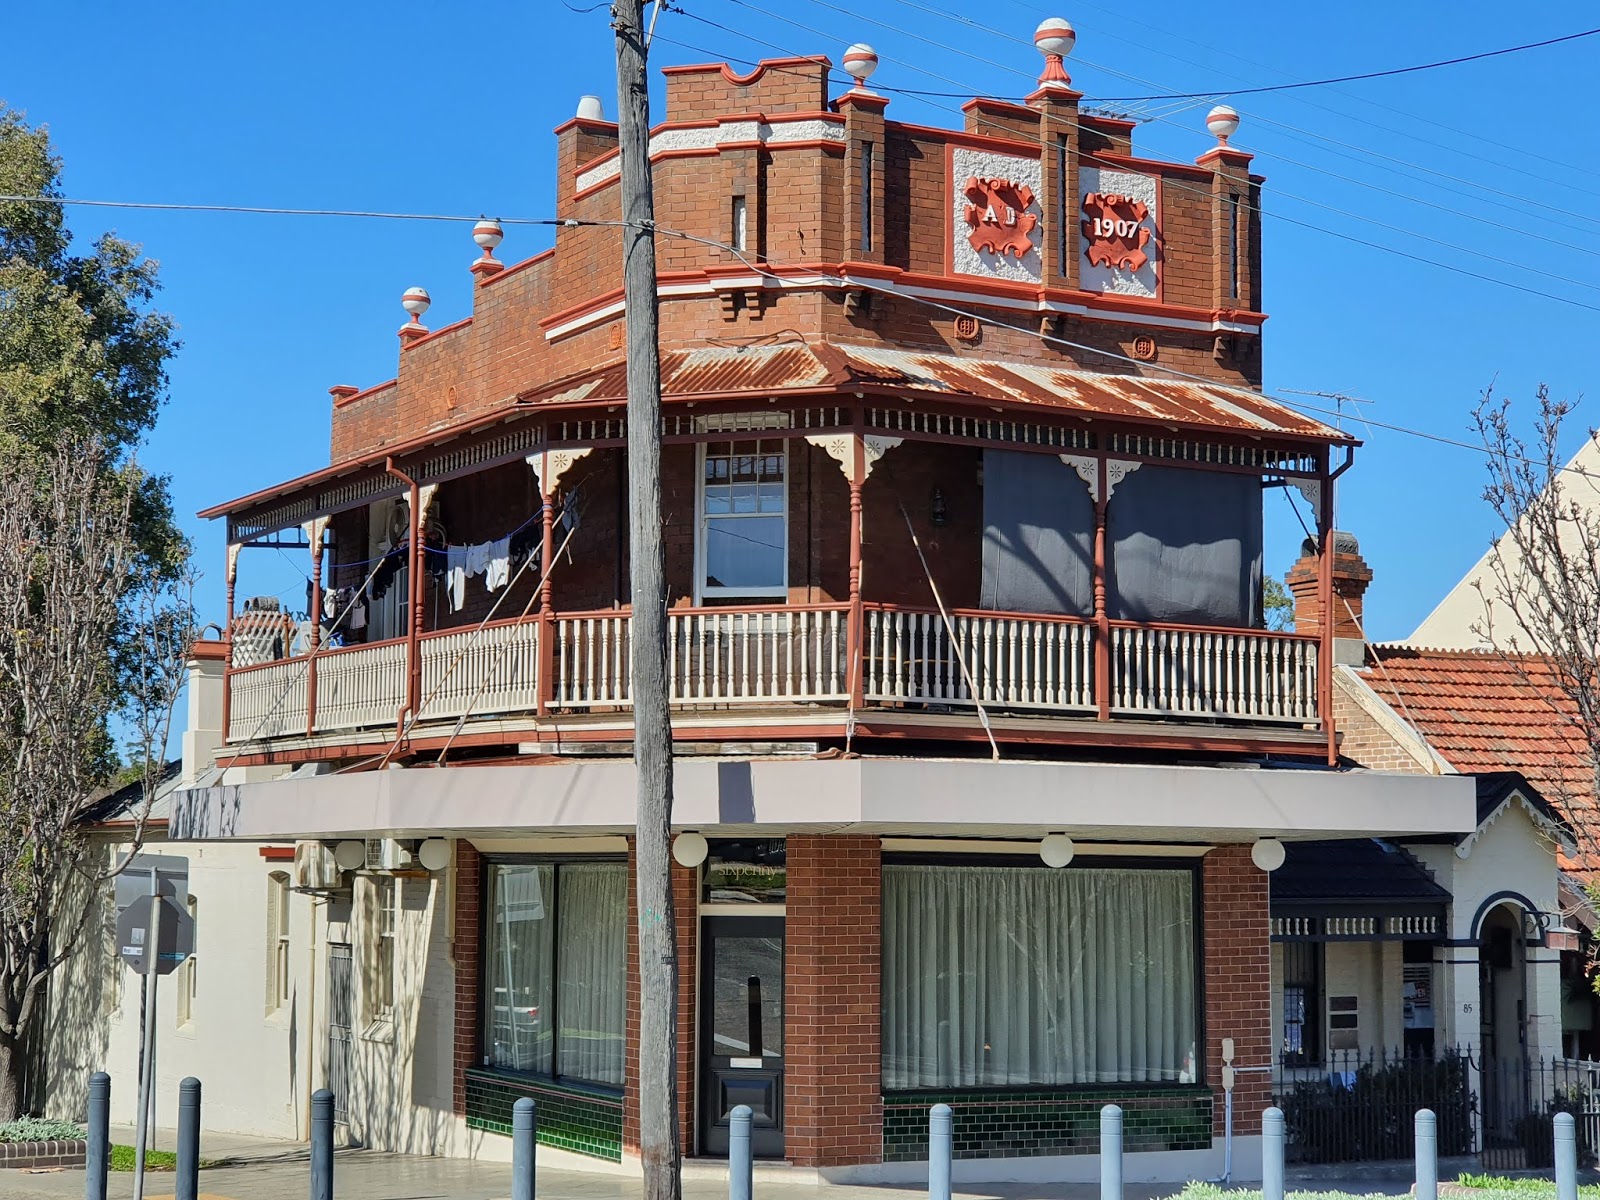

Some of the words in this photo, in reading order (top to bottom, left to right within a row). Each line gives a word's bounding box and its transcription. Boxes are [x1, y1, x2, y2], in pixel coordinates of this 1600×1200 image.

[982, 205, 998, 223] A
[1005, 207, 1016, 226] D
[1093, 217, 1140, 239] 1907
[719, 865, 776, 881] sixpenny
[1463, 1003, 1473, 1014] 85
